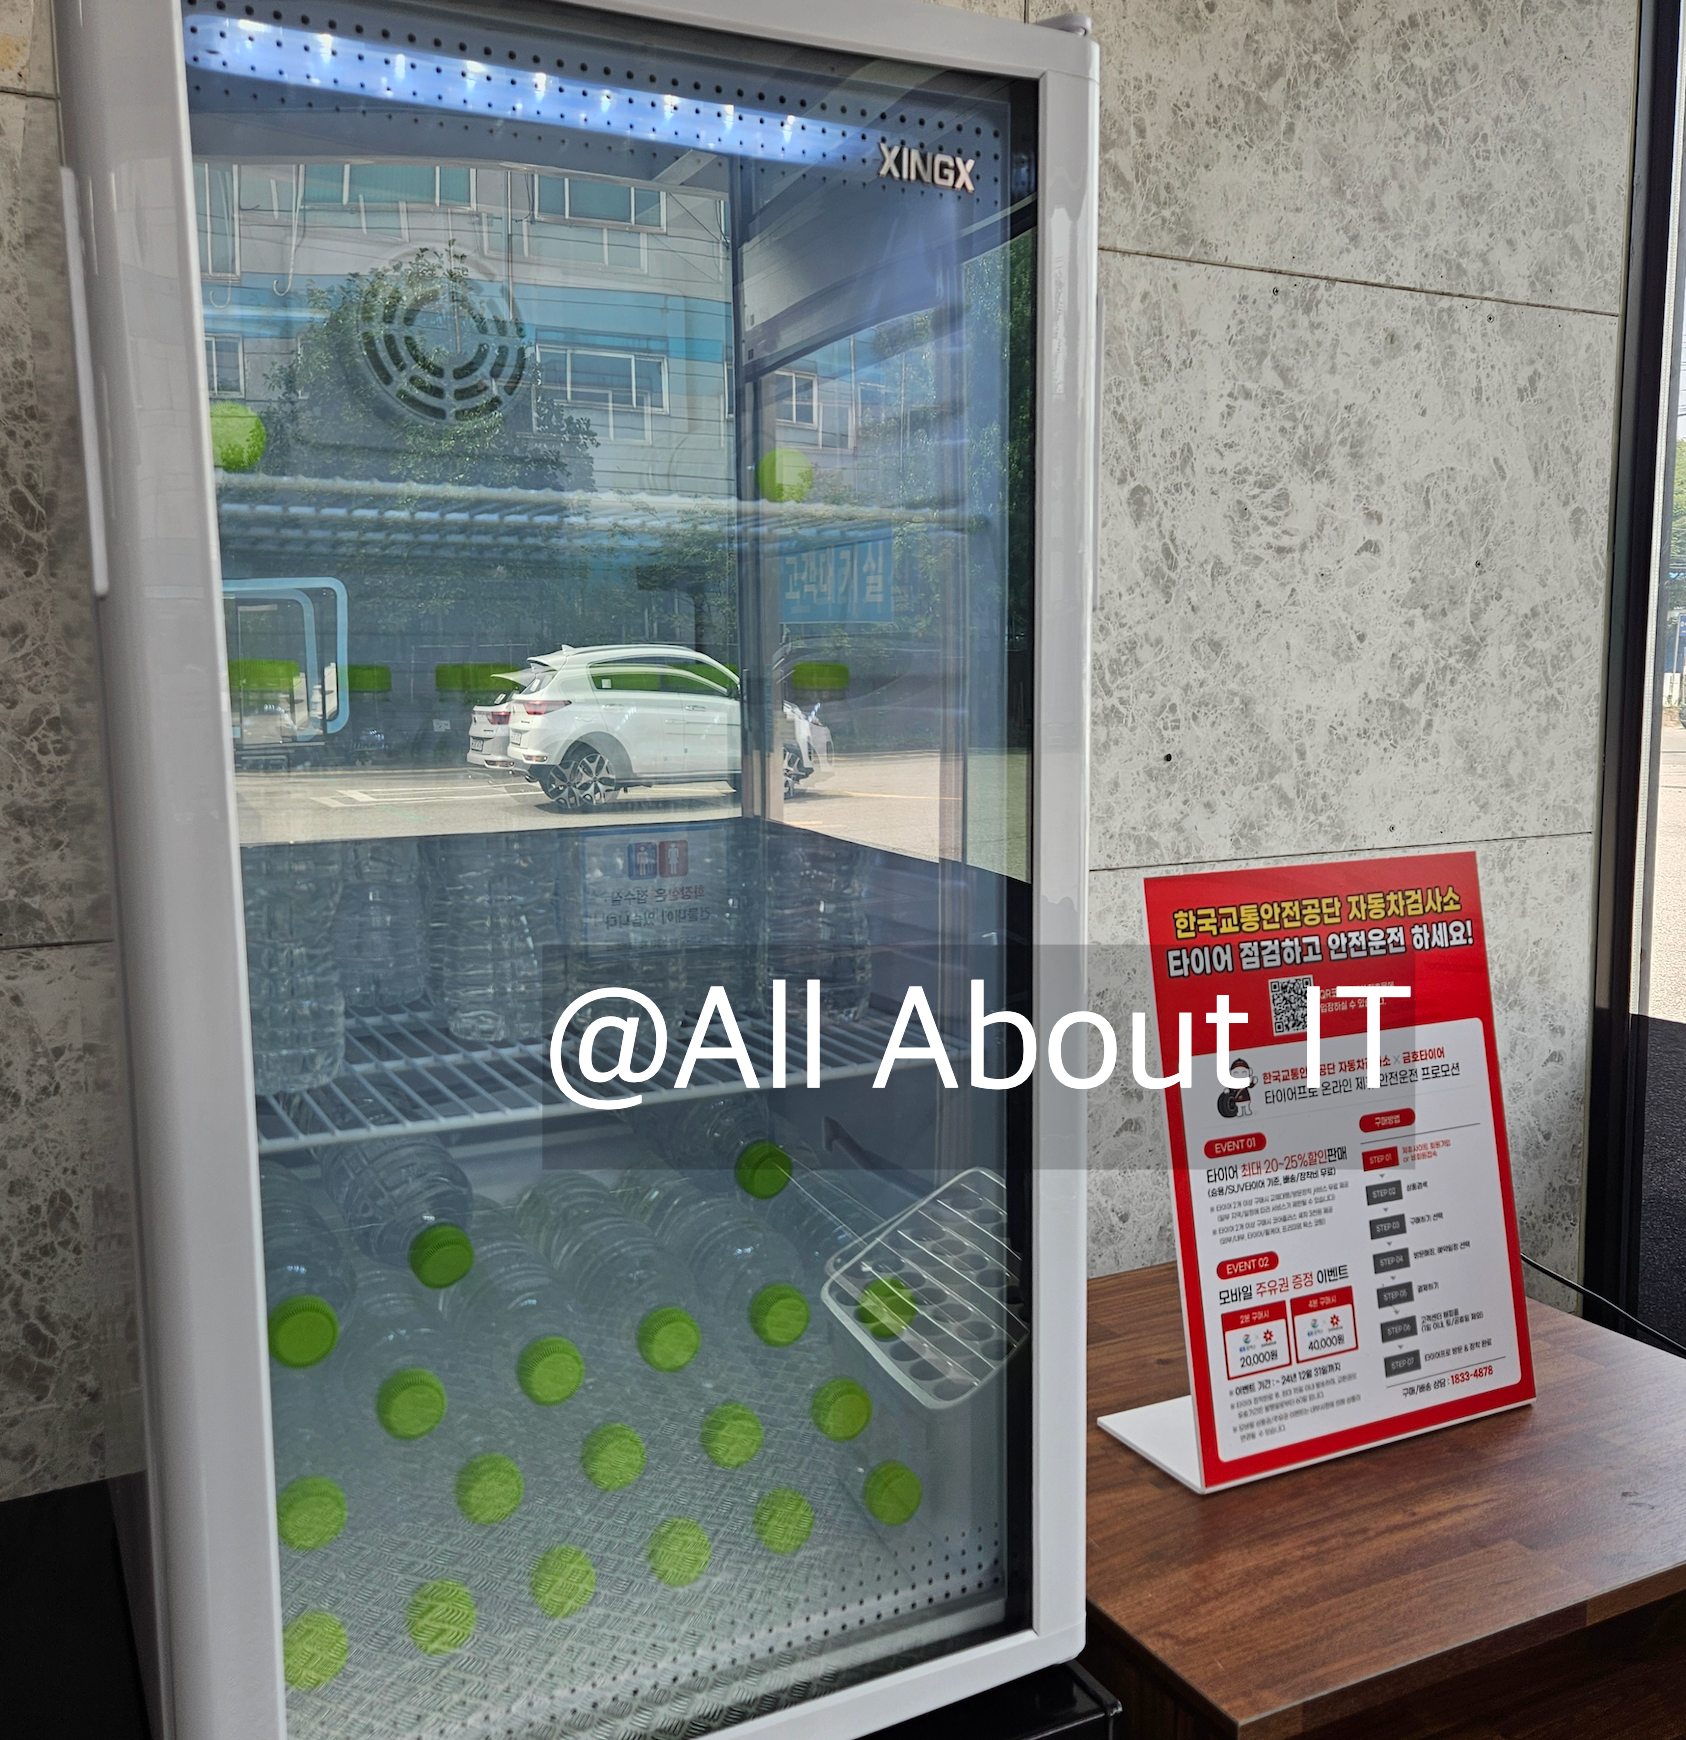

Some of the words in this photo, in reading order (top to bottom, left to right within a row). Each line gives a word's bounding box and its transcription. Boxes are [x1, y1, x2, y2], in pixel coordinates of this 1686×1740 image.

[879, 142, 975, 194] XINGX
[1173, 896, 1342, 939] 한국교통안전공단
[1347, 886, 1462, 921] 자동차검사소
[1167, 943, 1234, 978] 타이어
[1239, 935, 1323, 971] 점검하고
[1327, 925, 1407, 961] 안전운전
[1410, 919, 1474, 951] 하세요!
[1262, 1062, 1336, 1085] 한국교통안공단
[1338, 1055, 1391, 1073] 자동차소
[1402, 1047, 1445, 1065] 금호타이어
[1321, 1079, 1353, 1096] 온라인
[1421, 1062, 1461, 1081] 프로모션
[1214, 1139, 1245, 1154] EVENT
[1246, 1137, 1256, 1148] 01
[1369, 1154, 1385, 1165] STEP
[1206, 1164, 1239, 1183] 타이어
[1241, 1160, 1262, 1178] 최대
[1372, 1188, 1388, 1199] STEP
[1376, 1223, 1391, 1233] STEP
[1226, 1258, 1257, 1275] EVENT
[1258, 1256, 1269, 1268] 02
[1380, 1257, 1395, 1267] STEP
[1219, 1284, 1253, 1306] 모바일
[1256, 1277, 1289, 1298] 주유권
[1292, 1271, 1314, 1290] 증정
[1317, 1264, 1349, 1284] 이벤트
[1383, 1291, 1399, 1301] STEP
[1387, 1326, 1402, 1336] STEP
[1308, 1333, 1345, 1351] 40,000원
[1239, 1349, 1278, 1368] 20,000원
[1391, 1360, 1406, 1370] STEP
[1450, 1365, 1494, 1385] 1833-4878
